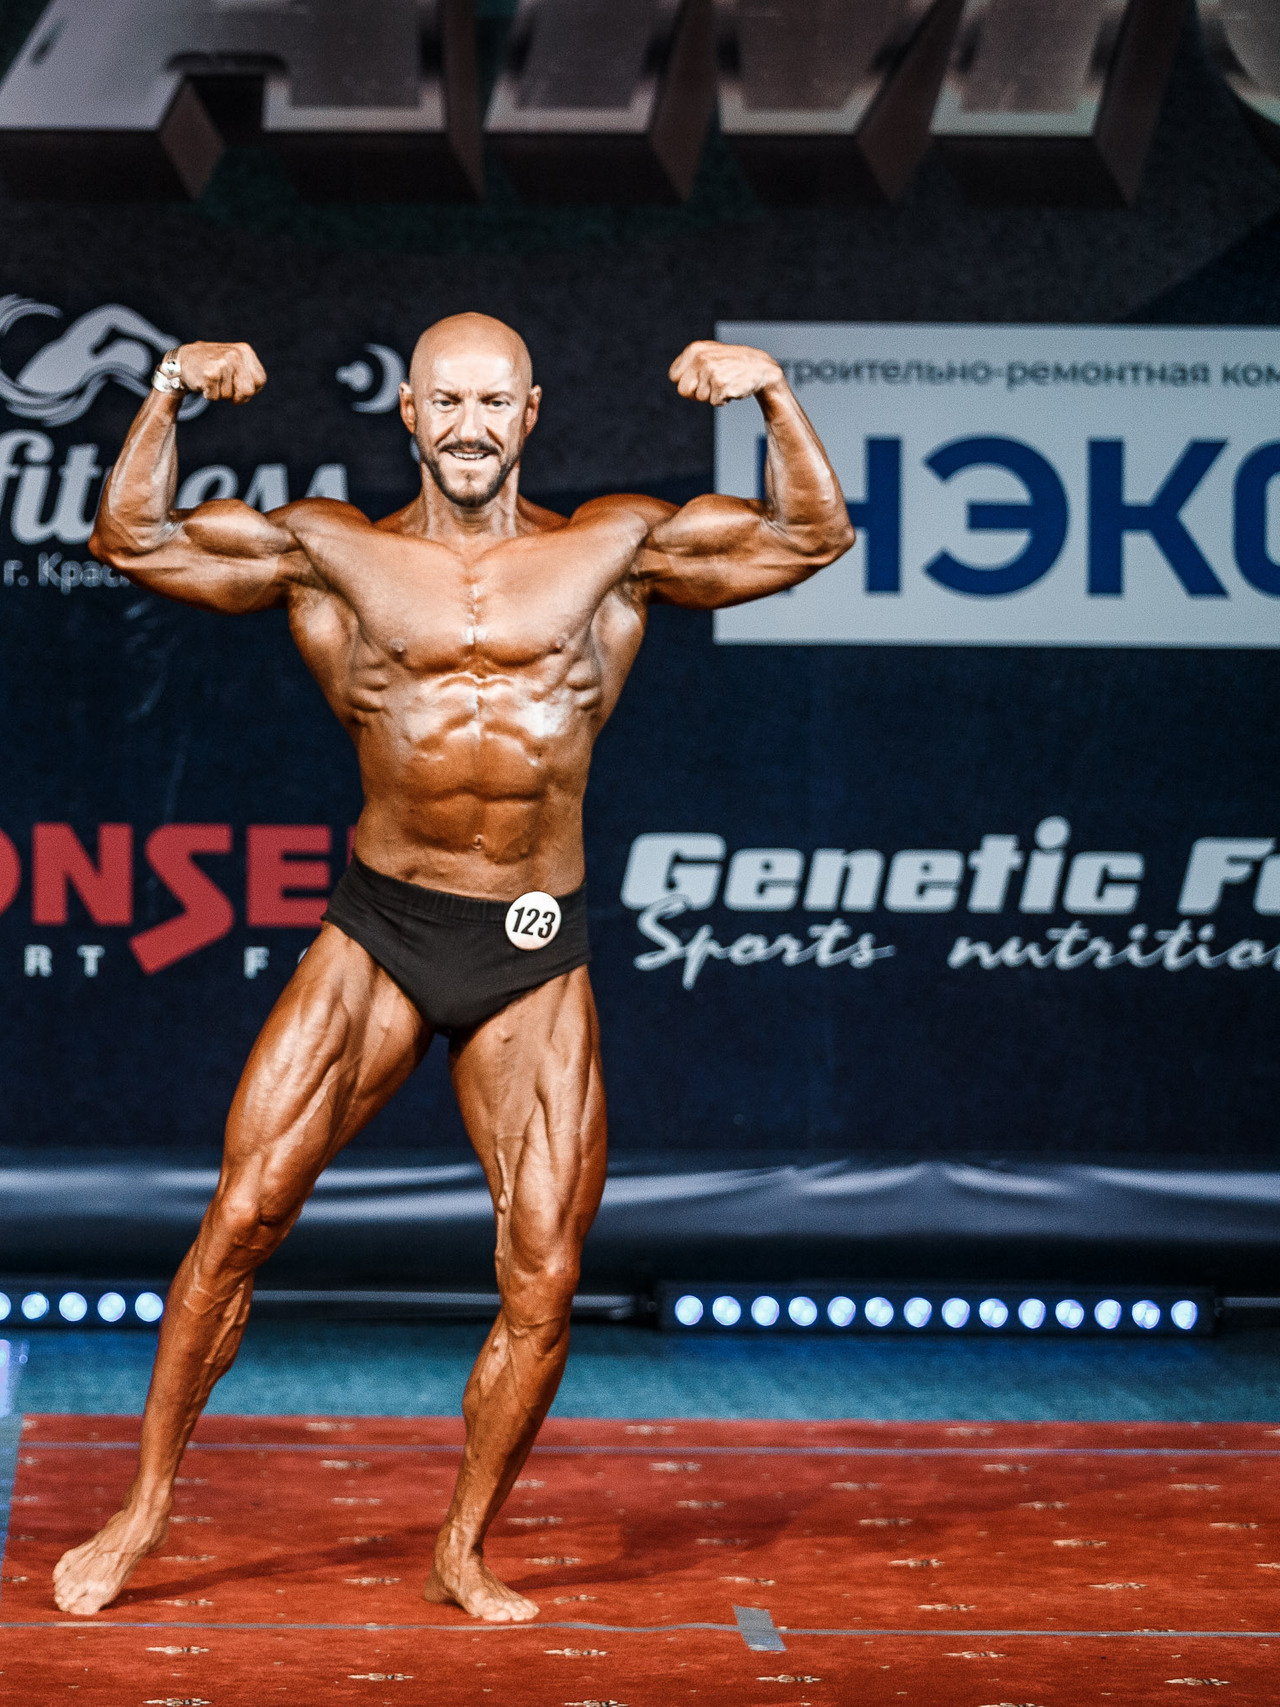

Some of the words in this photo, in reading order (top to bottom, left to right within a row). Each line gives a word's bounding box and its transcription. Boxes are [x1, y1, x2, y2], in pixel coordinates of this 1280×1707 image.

[37, 551, 130, 596] Крас
[621, 816, 1146, 915] Genetic
[512, 906, 556, 938] 123
[634, 894, 897, 990] Sports
[947, 917, 1280, 972] nutritio
